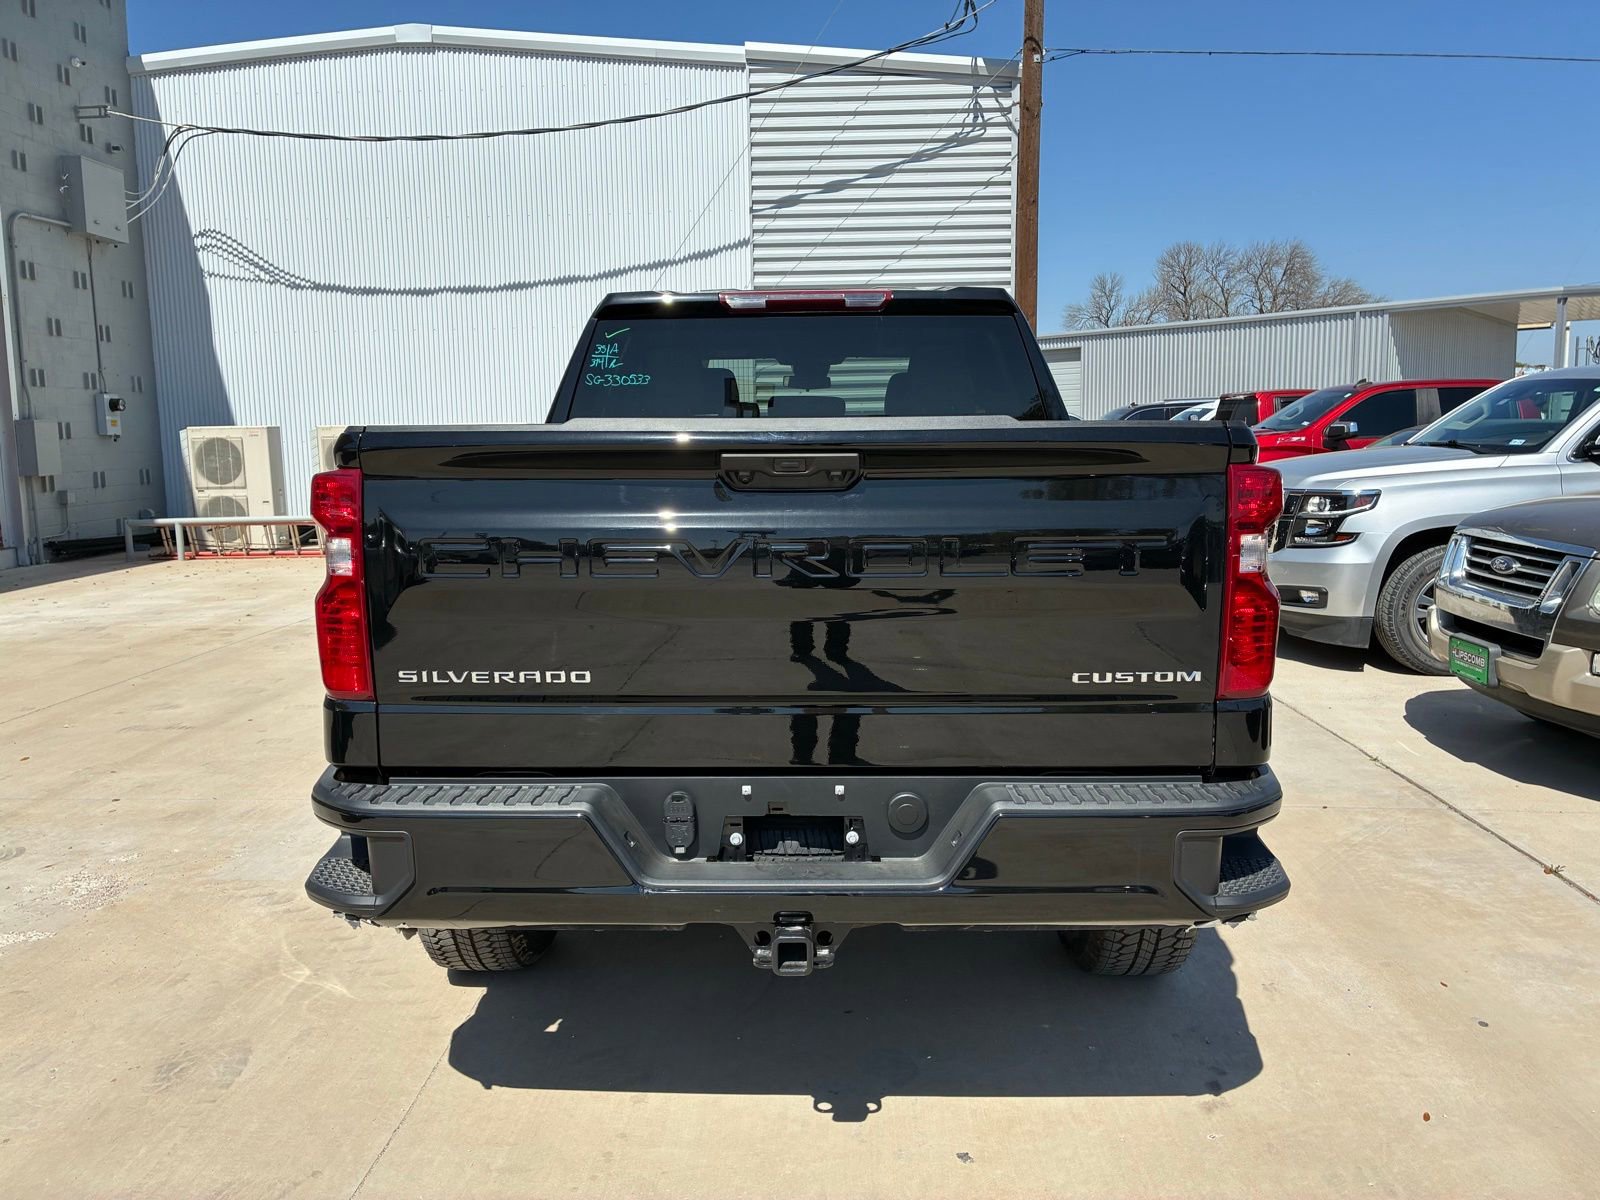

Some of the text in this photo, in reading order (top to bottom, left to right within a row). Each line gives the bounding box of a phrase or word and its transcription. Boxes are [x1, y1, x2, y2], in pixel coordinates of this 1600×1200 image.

[418, 537, 1173, 578] CHEVROLET
[1453, 648, 1485, 667] LIPSCOMB
[398, 670, 592, 684] SILVERADO
[1072, 670, 1202, 684] CUSTOM
